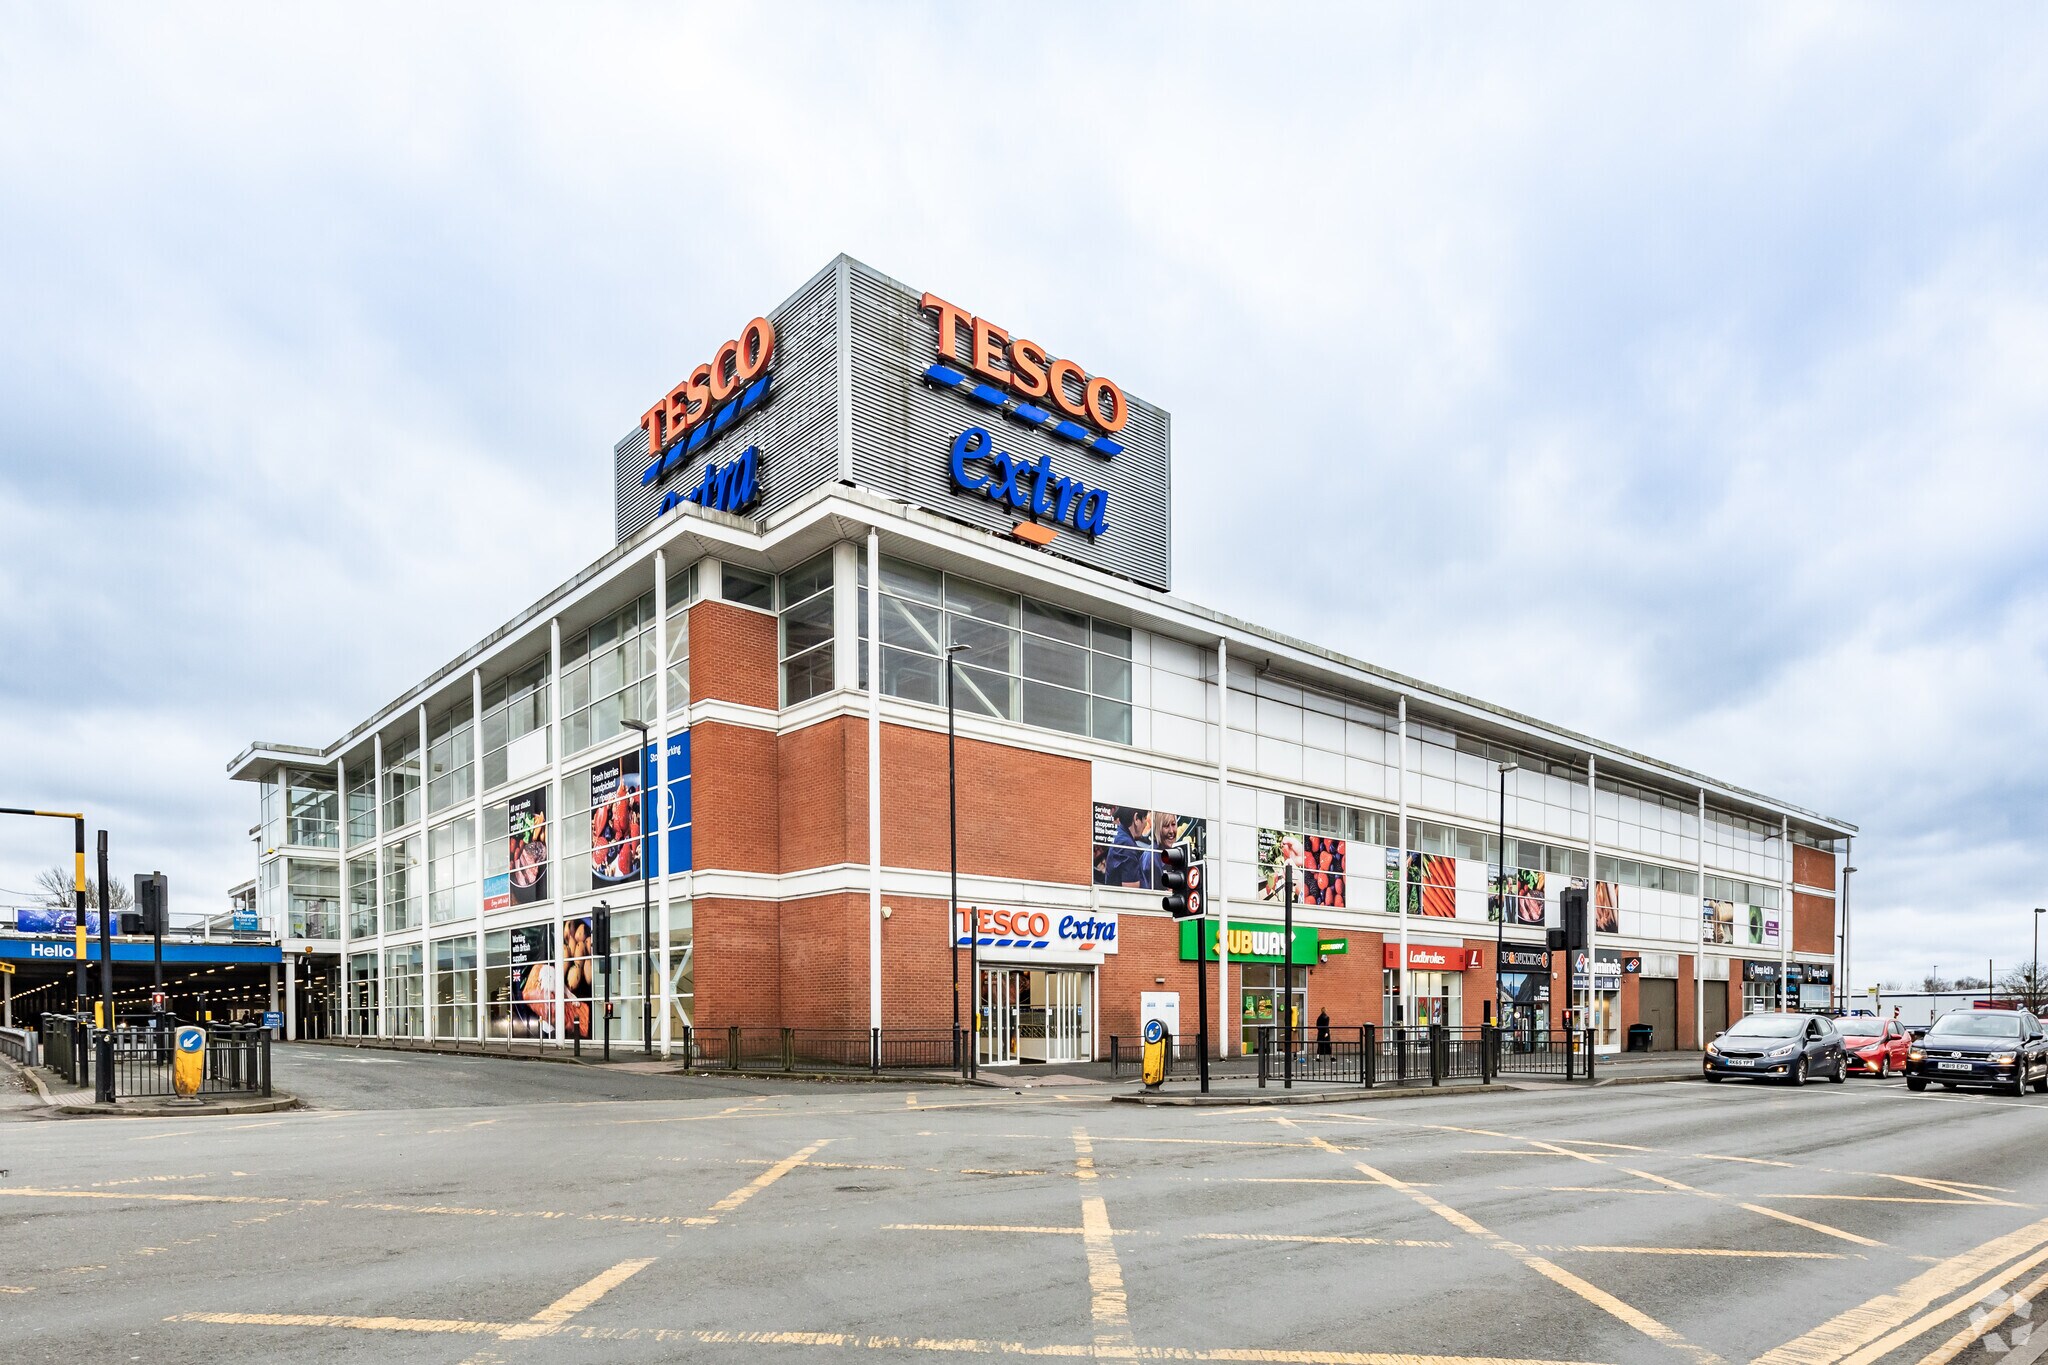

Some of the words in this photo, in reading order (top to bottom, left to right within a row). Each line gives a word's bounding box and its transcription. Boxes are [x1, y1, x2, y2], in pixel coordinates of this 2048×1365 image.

[921, 292, 1129, 433] TESCO
[641, 316, 775, 458] TESCO
[949, 426, 1110, 536] extra
[593, 772, 603, 783] Fresh
[604, 767, 619, 779] berries
[593, 778, 616, 794] handpicked
[1095, 806, 1111, 815] Serving
[1095, 813, 1114, 821] Oldham's
[1095, 820, 1114, 829] shoppers
[956, 907, 1050, 937] TESCO
[1058, 914, 1116, 941] extra
[1320, 943, 1345, 951] SUBWAY
[1409, 950, 1446, 965] Ladbrokes
[1470, 950, 1479, 965] L
[1584, 957, 1621, 975] Dmino's
